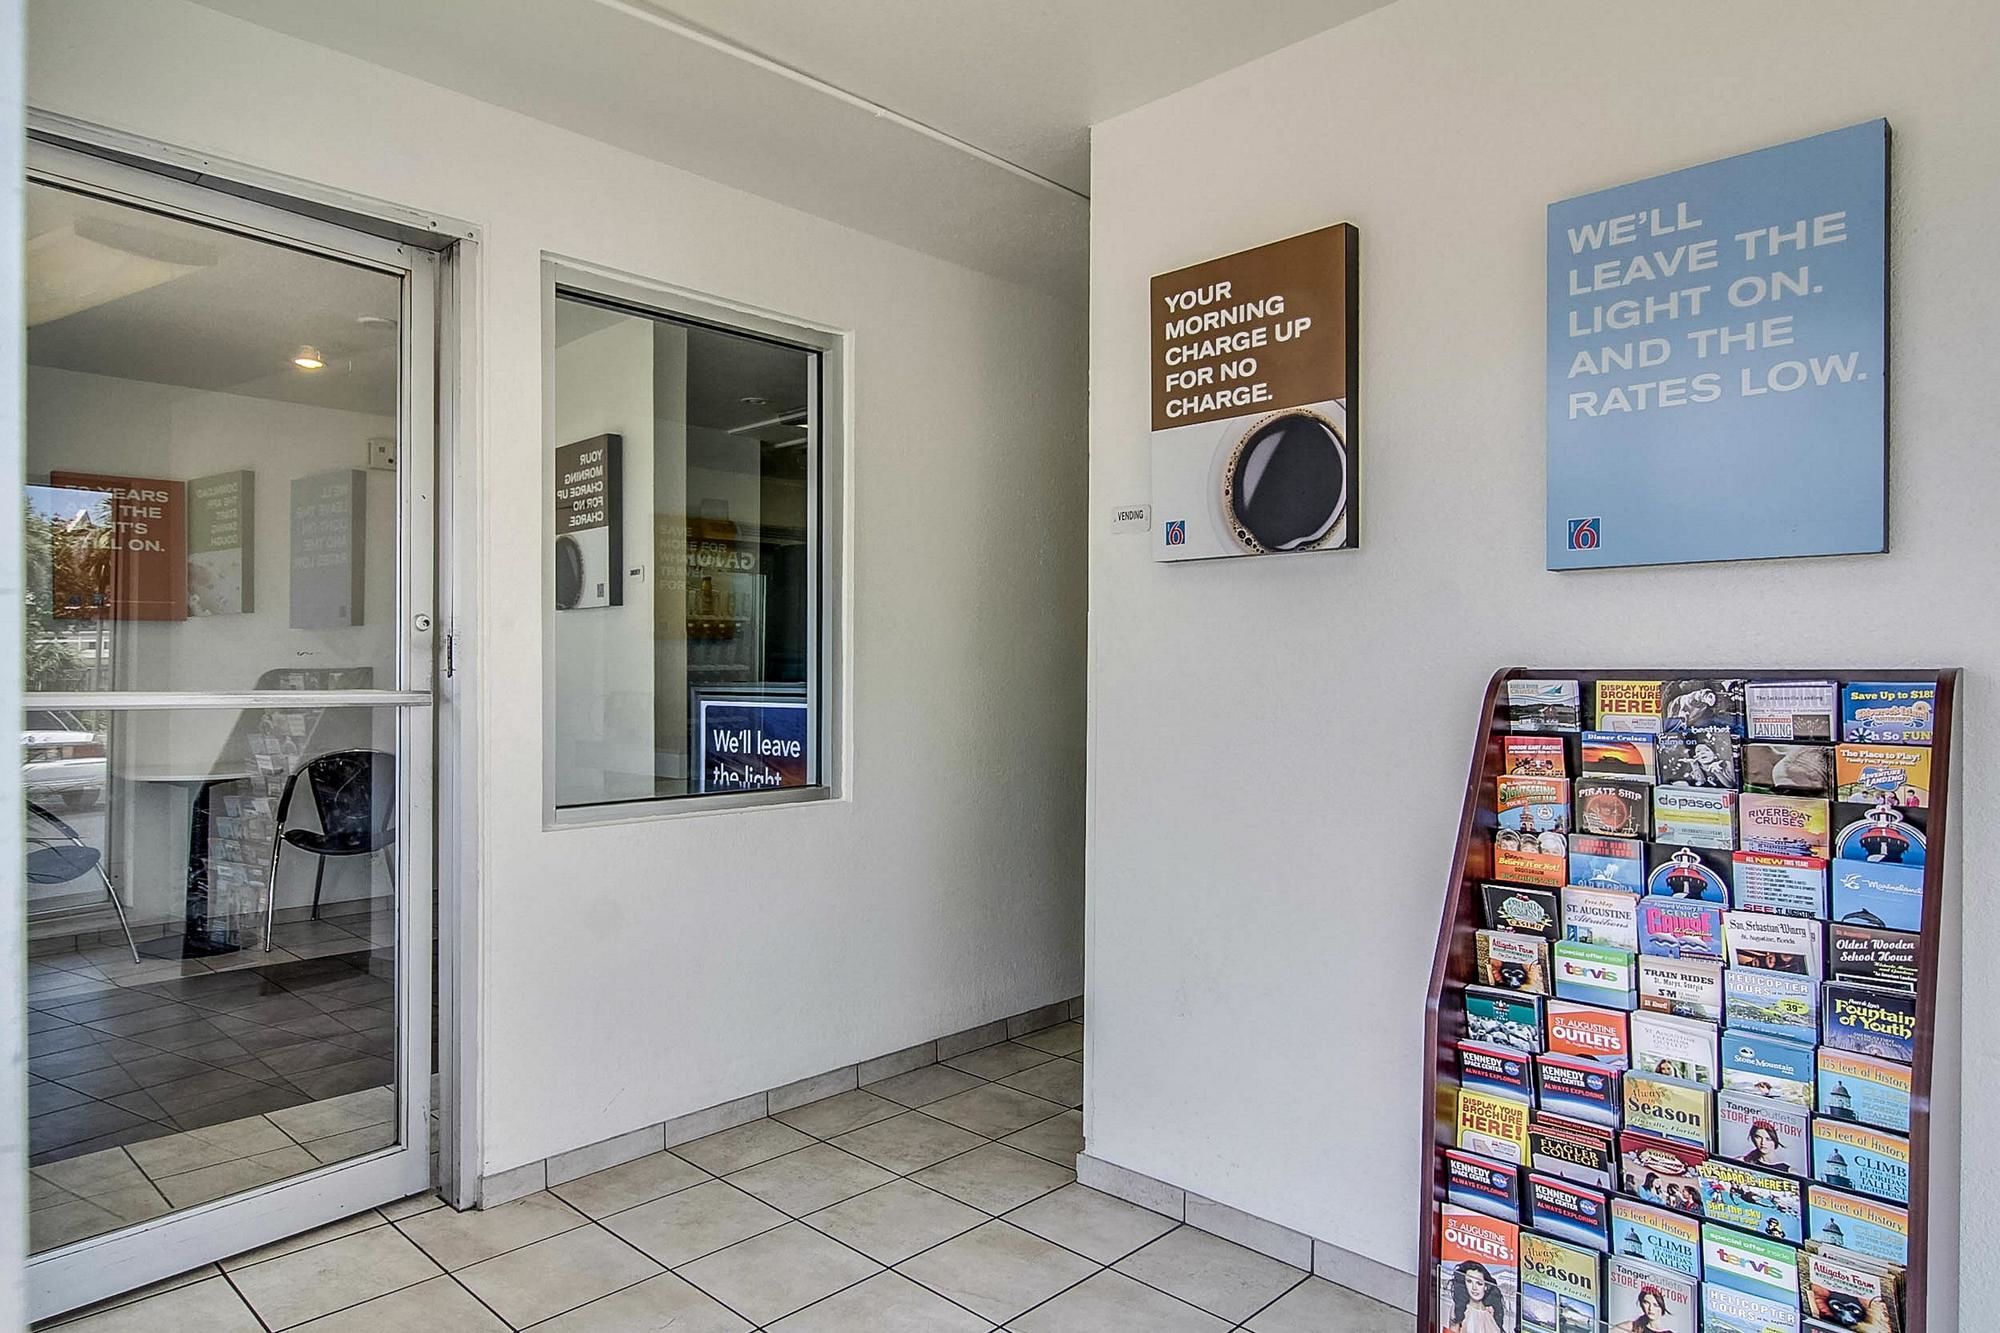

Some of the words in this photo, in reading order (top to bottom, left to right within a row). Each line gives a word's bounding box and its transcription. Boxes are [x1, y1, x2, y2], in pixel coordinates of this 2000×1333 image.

[1567, 202, 1703, 254] WE'LL
[1569, 240, 1718, 296] LEAVE
[1735, 211, 1847, 261] THE
[1165, 281, 1232, 313] YOUR
[1569, 285, 1712, 338] LIGHT
[1728, 266, 1824, 308] ON.
[1166, 295, 1285, 340] MORNING
[1166, 327, 1268, 366] CHARGE
[1274, 317, 1311, 343] UP
[1567, 338, 1671, 379] AND
[1688, 316, 1794, 359] THE
[1166, 368, 1214, 393] FOR
[1221, 358, 1257, 382] NO
[1569, 373, 1722, 420] RATES
[1741, 352, 1867, 397] LOW.
[1166, 383, 1273, 418] CHARGE.
[120, 505, 162, 518] THE
[1118, 510, 1144, 522] VENDING
[129, 540, 165, 551] ON.
[1601, 684, 1637, 692] DISPLAY
[1601, 691, 1661, 700] BROCHURE
[1851, 692, 1877, 700] Save
[1880, 691, 1895, 701] Up
[1910, 690, 1934, 699] $18!
[1600, 699, 1662, 713] HERE!
[1617, 734, 1647, 742] Cruises
[1691, 725, 1731, 733] bestbet
[1754, 724, 1791, 736] LANDING
[1882, 731, 1900, 740] So
[713, 729, 751, 754] We'll
[756, 729, 800, 758] leave
[1840, 749, 1858, 758] The
[1859, 751, 1884, 759] Place
[1896, 752, 1921, 762] Play!
[1578, 787, 1615, 798] PIRATE
[1618, 788, 1642, 801] SHIP
[1748, 809, 1812, 822] RIVERBOAT
[1755, 817, 1805, 828] CRUISES
[1863, 880, 1923, 893] Marineland
[1566, 904, 1578, 913] ST.
[1579, 906, 1633, 921] AUGUSTINE
[1662, 909, 1699, 918] SCENIC
[1744, 904, 1774, 913] SEE
[1568, 914, 1629, 929] Attractions
[1730, 921, 1745, 930] San
[1747, 921, 1779, 932] Sebastian
[1779, 925, 1806, 937] Winery
[1493, 938, 1517, 952] Alligator
[1518, 944, 1535, 956] Farm
[1560, 949, 1584, 957] special
[1836, 939, 1869, 950] Oldest
[1870, 939, 1915, 950] Wooden
[1840, 951, 1875, 962] School
[1877, 952, 1913, 962] House
[1564, 962, 1617, 981] tervis
[1644, 969, 1677, 979] TRAIN
[1681, 974, 1714, 985] RIDES
[1728, 973, 1808, 993] HELICOPTER
[1728, 983, 1770, 996] TOURS
[1835, 999, 1916, 1028] Fountain
[1555, 1017, 1565, 1026] ST.
[1568, 1021, 1617, 1036] AUGUSTINE
[1840, 1015, 1857, 1027] of
[1859, 1016, 1912, 1040] Youth
[1552, 1028, 1621, 1050] OUTLETS
[1463, 1051, 1502, 1067] KENNEDY
[1463, 1060, 1481, 1069] SPACE
[1482, 1063, 1503, 1073] CENTER
[1466, 1068, 1488, 1077] ALWAYS
[1489, 1072, 1521, 1085] EXPLORING
[1543, 1065, 1584, 1081] KENNEDY
[1543, 1074, 1561, 1083] SPACE
[1562, 1077, 1585, 1088] CENTER
[1822, 1059, 1835, 1069] 175
[1839, 1061, 1856, 1072] feet
[1861, 1065, 1871, 1076] of
[1875, 1069, 1908, 1090] History
[1544, 1083, 1569, 1093] ALWAYS
[1570, 1087, 1604, 1100] EXPLORING
[1632, 1089, 1665, 1100] Always
[1463, 1096, 1497, 1111] DISPLAY
[1499, 1105, 1523, 1118] YOUR
[1463, 1104, 1522, 1126] BROCHURE
[1628, 1097, 1700, 1126] Season
[1462, 1113, 1522, 1141] HERE!
[1671, 1126, 1700, 1137] Florida
[1721, 1110, 1748, 1124] STORE
[1753, 1117, 1802, 1137] DIRECTORY
[1541, 1139, 1597, 1160] FLAGLER
[1818, 1126, 1831, 1136] 175
[1835, 1128, 1853, 1141] feet
[1857, 1133, 1868, 1145] of
[1871, 1138, 1905, 1160] History
[1541, 1146, 1599, 1168] COLLEGE
[1855, 1156, 1906, 1177] CLIMB
[1451, 1160, 1490, 1178] KENNEDY
[1451, 1168, 1469, 1178] SPACE
[1470, 1172, 1491, 1185] CENTER
[1452, 1177, 1476, 1188] ALWAYS
[1477, 1184, 1508, 1198] EXPLORING
[1536, 1185, 1577, 1204] KENNEDY
[1862, 1178, 1906, 1195] TALLEST
[1536, 1193, 1555, 1204] SPACE
[1556, 1199, 1578, 1211] CENTER
[1537, 1202, 1562, 1215] ALWAYS
[1563, 1210, 1598, 1225] EXPLORING
[1814, 1195, 1826, 1207] 175
[1831, 1199, 1849, 1213] feet
[1853, 1206, 1863, 1217] of
[1868, 1211, 1904, 1231] History
[1448, 1219, 1458, 1228] ST.
[1460, 1223, 1505, 1243] AUGUSTINE
[1616, 1209, 1628, 1218] 175
[1630, 1209, 1648, 1223] feet
[1649, 1215, 1660, 1226] of
[1661, 1219, 1692, 1240] History
[1444, 1229, 1509, 1260] OUTLETS
[1648, 1235, 1692, 1256] CLIMB
[1711, 1233, 1742, 1247] special
[1744, 1242, 1765, 1252] offer
[1528, 1248, 1559, 1259] Always
[1524, 1255, 1592, 1290] Season
[1717, 1248, 1783, 1279] tervis
[1814, 1262, 1849, 1281] Alligator
[1851, 1274, 1875, 1290] Farm
[1564, 1287, 1592, 1300] Florida
[1611, 1272, 1638, 1288] STORE
[1641, 1281, 1689, 1305] DIRECTORY
[1711, 1291, 1795, 1322] HELICOPTER
[1711, 1301, 1755, 1321] TOURS
